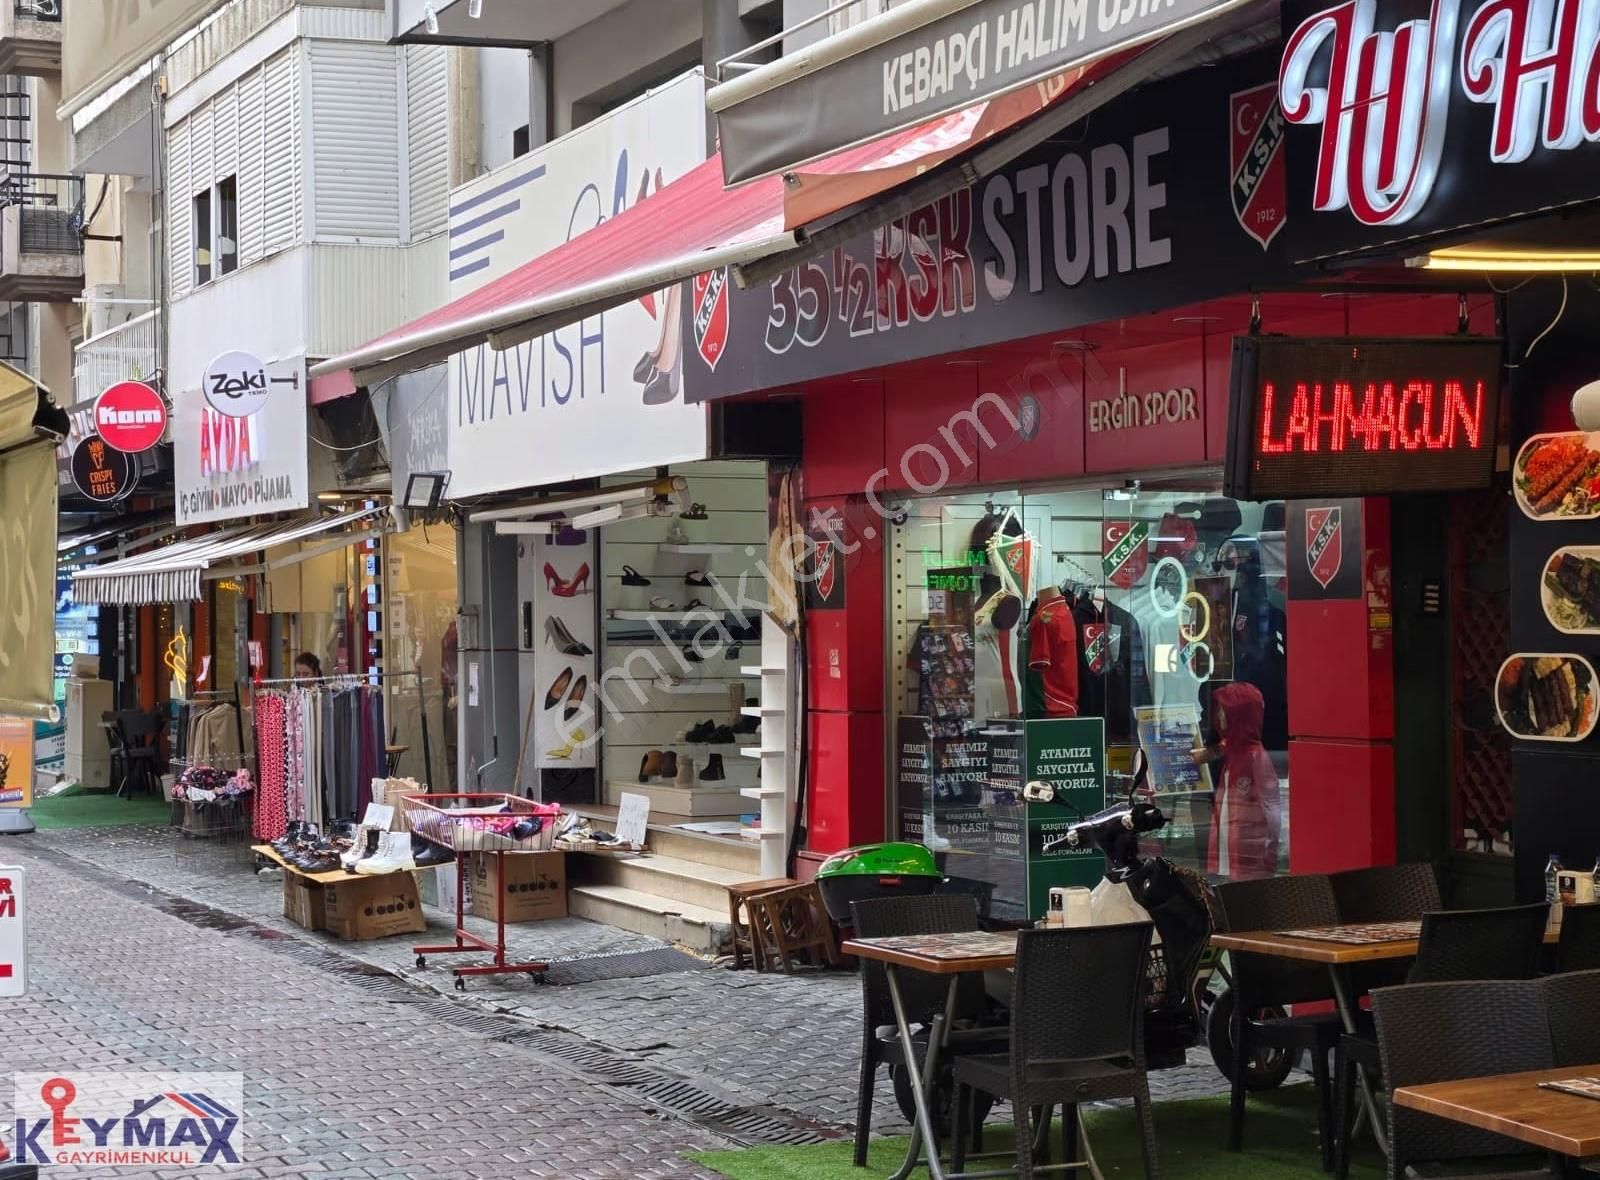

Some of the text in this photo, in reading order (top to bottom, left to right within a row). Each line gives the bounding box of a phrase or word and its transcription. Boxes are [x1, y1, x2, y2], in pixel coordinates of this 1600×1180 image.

[883, 22, 986, 115] KEBAPÇI
[983, 126, 1172, 300] STORE
[1256, 208, 1275, 222] 1912
[210, 369, 266, 398] Zeki
[1145, 388, 1196, 425] SPOR
[1261, 380, 1484, 453] LAHMACUN
[89, 470, 113, 483] CRISPY
[92, 482, 116, 496] FRIES
[221, 485, 248, 507] MAYO
[254, 475, 293, 504] PİJAMA
[1039, 748, 1092, 759] ATAMIZI
[1036, 763, 1096, 775] SAYGIYLA
